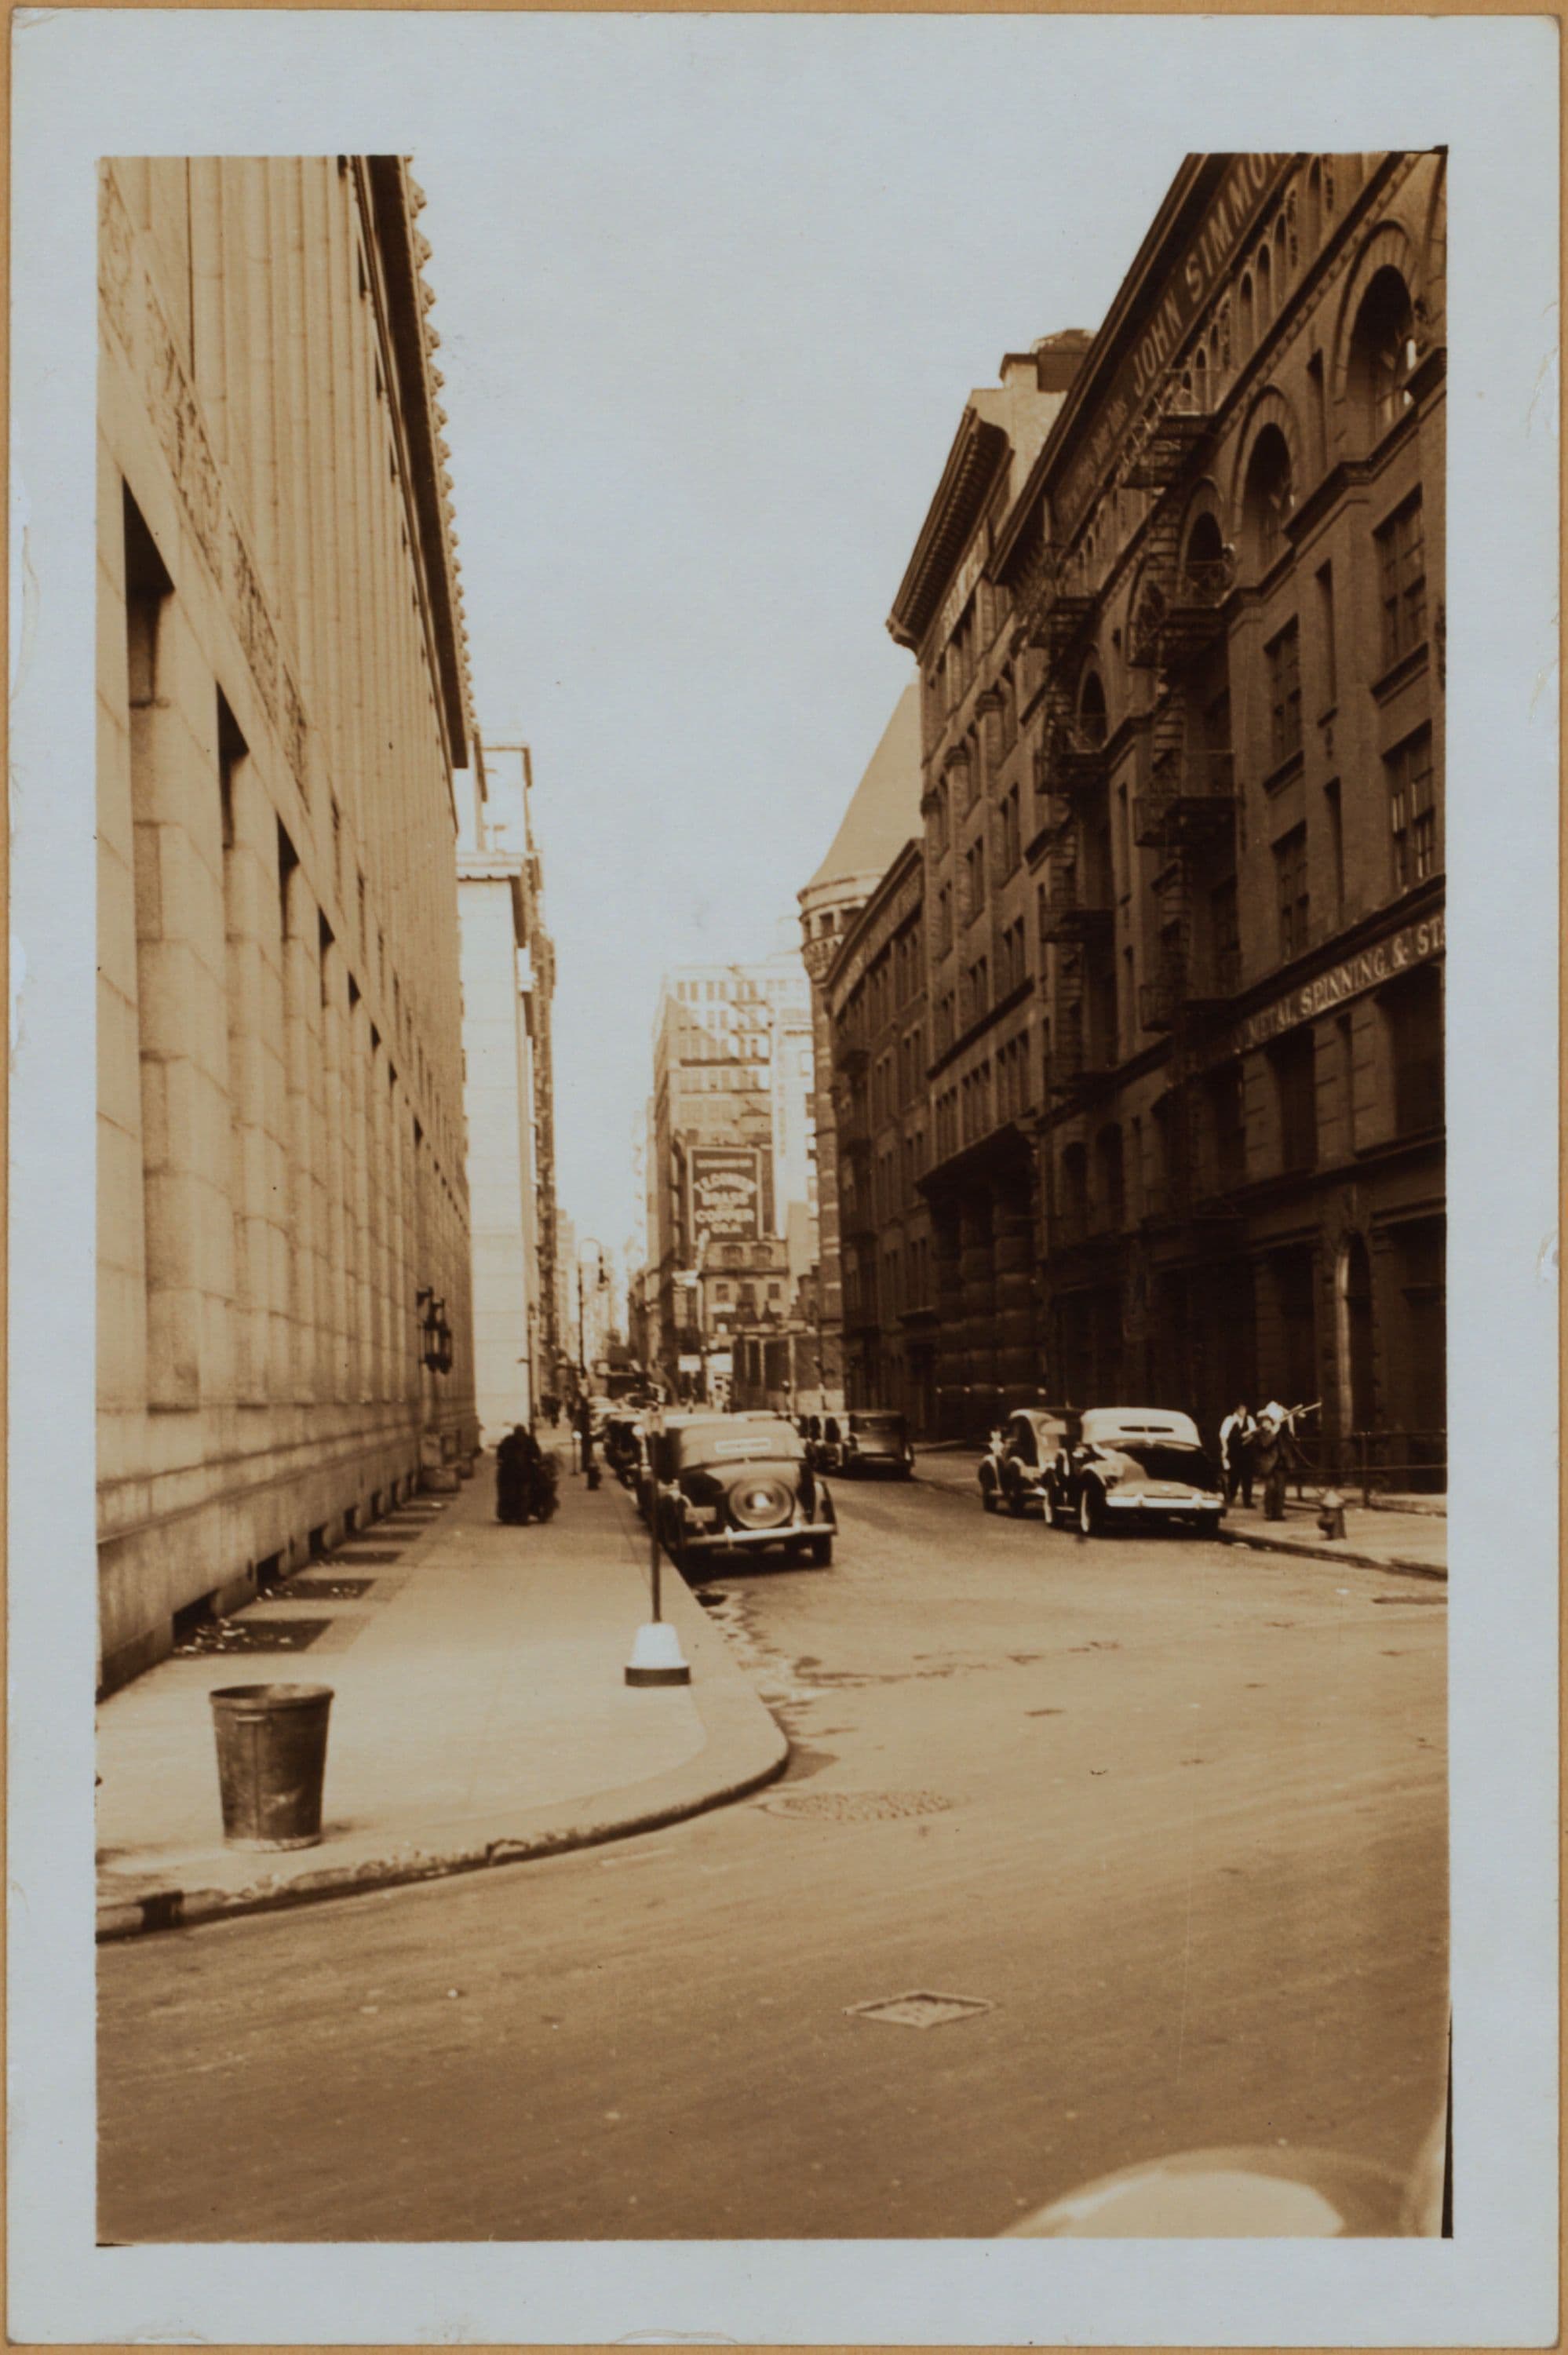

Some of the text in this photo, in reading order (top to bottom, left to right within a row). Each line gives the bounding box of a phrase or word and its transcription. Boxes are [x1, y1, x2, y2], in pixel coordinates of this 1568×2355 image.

[1134, 153, 1276, 397] JOHN SIMMO
[1300, 948, 1385, 1015] SPINNING
[1392, 936, 1409, 968] &
